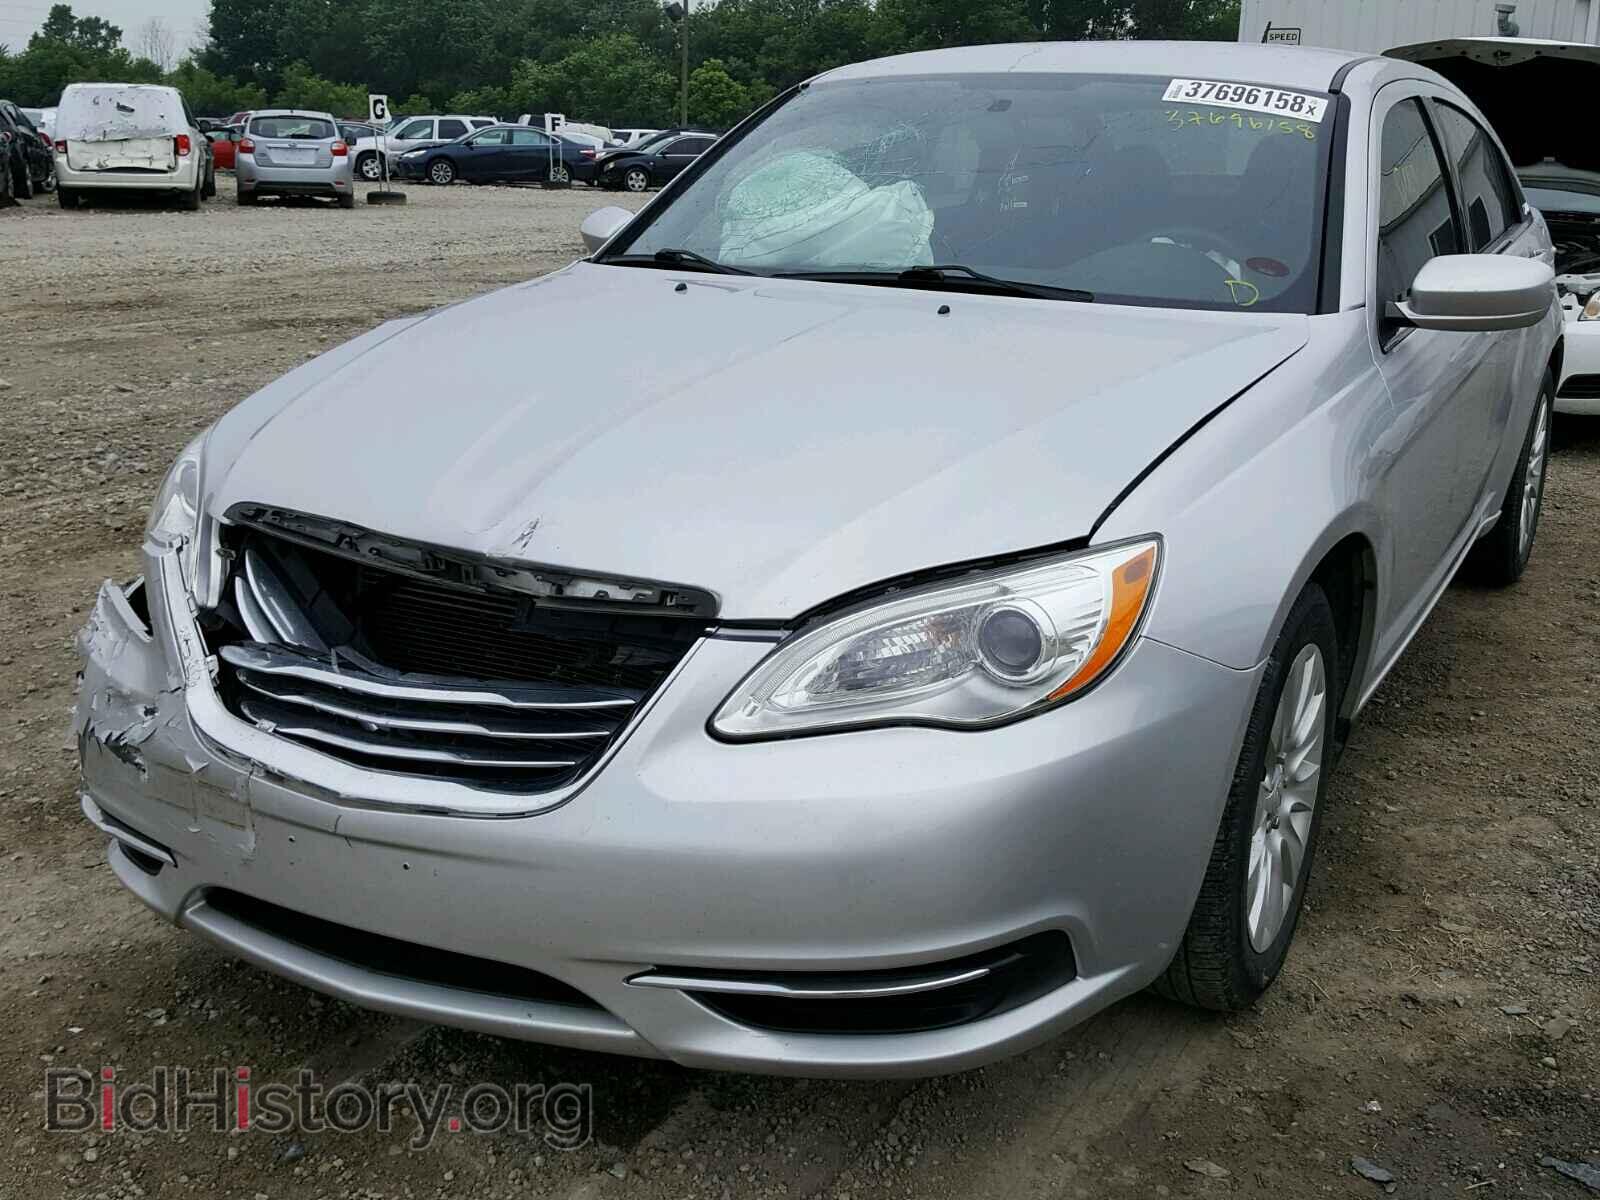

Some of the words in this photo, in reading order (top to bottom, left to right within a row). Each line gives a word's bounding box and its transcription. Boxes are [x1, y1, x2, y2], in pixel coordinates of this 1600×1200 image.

[372, 98, 385, 120] G
[1185, 81, 1306, 113] 37696158
[552, 116, 561, 131] F
[1166, 110, 1315, 140] 37696158
[1224, 279, 1259, 307] D
